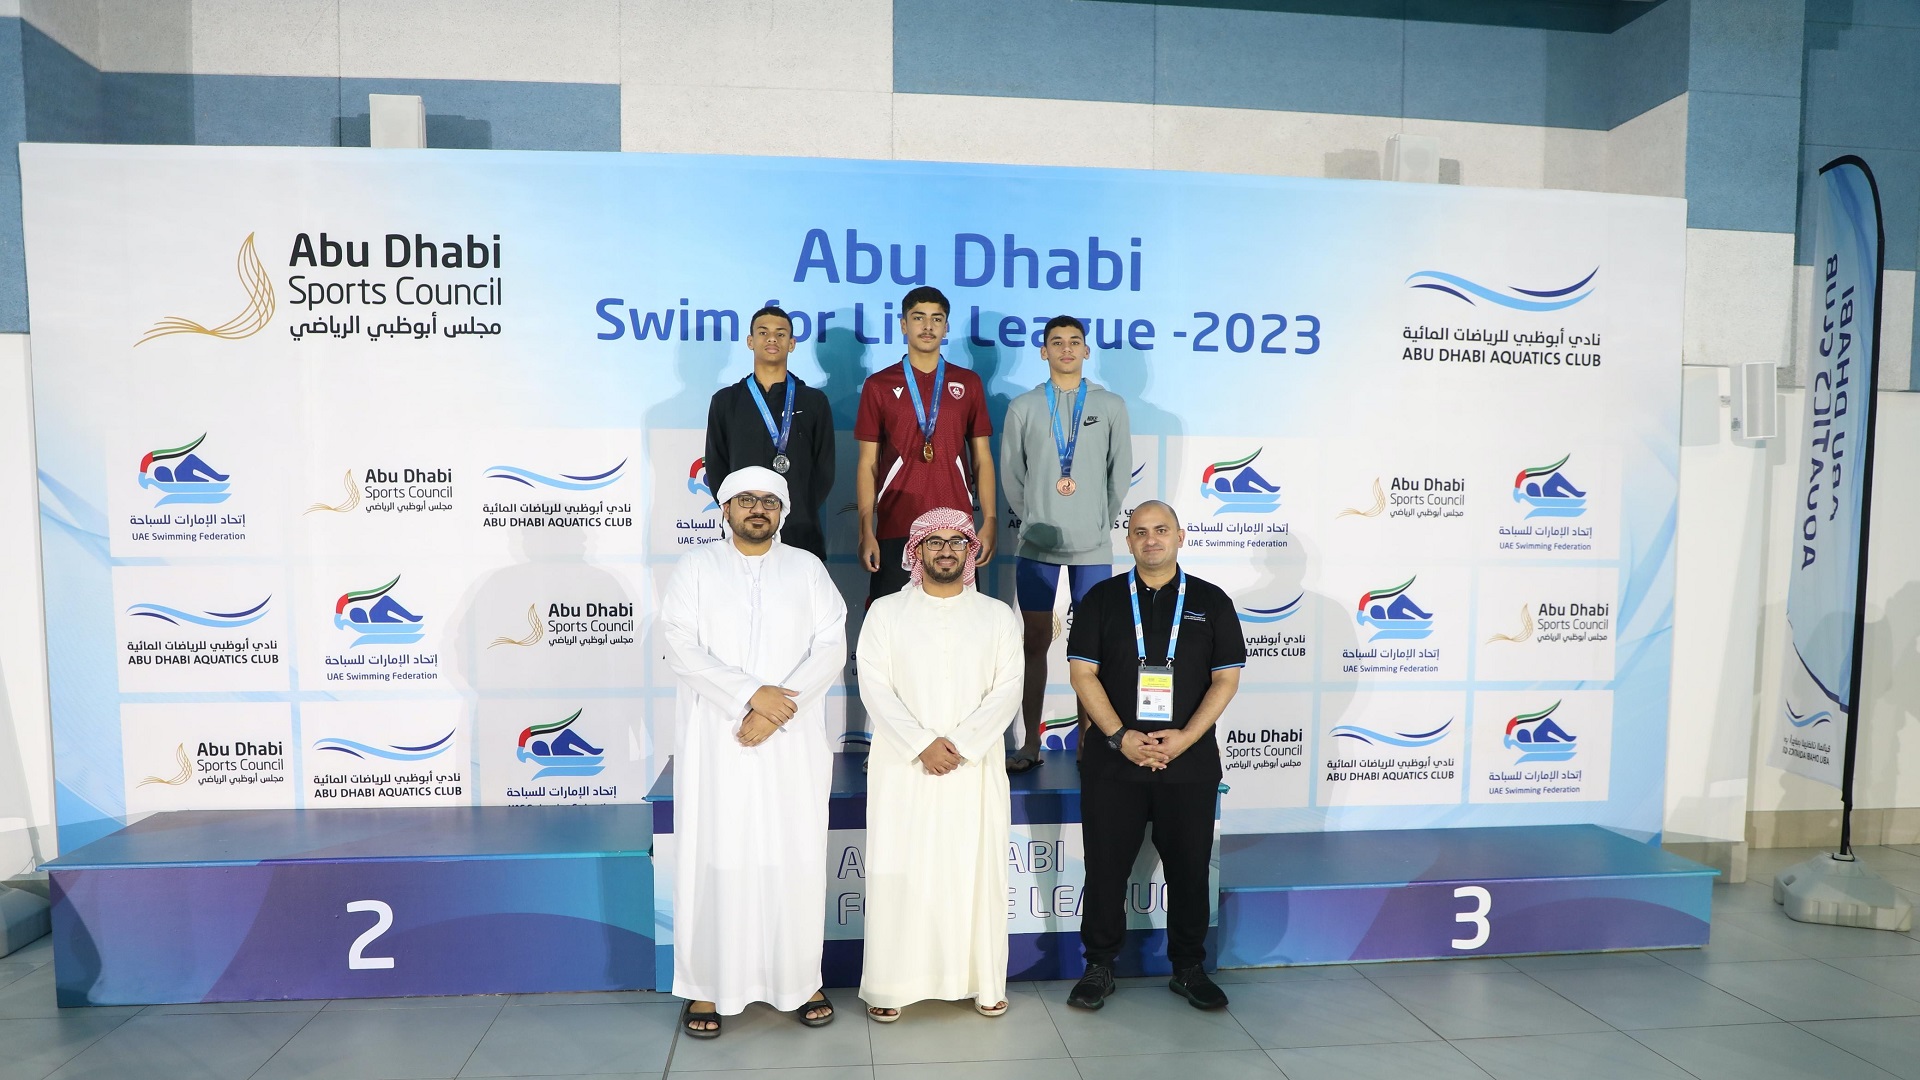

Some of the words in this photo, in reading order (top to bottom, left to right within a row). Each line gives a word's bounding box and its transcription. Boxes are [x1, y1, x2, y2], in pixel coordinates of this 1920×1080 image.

[289, 232, 369, 268] Abu
[385, 233, 501, 269] Dhabi
[794, 228, 926, 286] Abu
[955, 234, 1142, 292] Dhabi
[288, 275, 387, 311] Sports
[396, 276, 502, 306] Council
[290, 315, 360, 342] الرياضي
[367, 311, 437, 342] أبوظبي
[443, 316, 502, 339] مجلس
[596, 298, 739, 341] Swim
[764, 299, 836, 343] or
[855, 302, 949, 345] Li
[1174, 313, 1321, 356] -2023
[1403, 325, 1449, 343] المائية
[1453, 328, 1509, 346] للرياضات
[1513, 327, 1565, 348] أبوظبي
[1568, 333, 1601, 348] نادي
[1402, 347, 1434, 361] ABU
[1439, 348, 1486, 363] DHABI
[1489, 350, 1561, 366] AQUATICS
[1565, 353, 1601, 367] CLUB
[365, 468, 398, 483] Abu
[404, 468, 452, 483] Dhabi
[1390, 477, 1419, 491] Abu
[1424, 477, 1465, 492] Dhabi
[364, 486, 406, 501] Sports
[408, 485, 453, 498] Council
[396, 500, 426, 513] أبوظبي
[1390, 493, 1425, 507] Sports
[1427, 493, 1465, 506] Council
[365, 502, 395, 513] الرياضي
[428, 502, 453, 512] مجلس
[482, 502, 517, 515] المائية
[520, 503, 561, 516] للرياضات
[564, 500, 603, 516] أبوظبي
[606, 503, 631, 515] نادي
[1390, 508, 1415, 518] الرياضي
[1416, 507, 1442, 519] أبوظبي
[1443, 509, 1464, 518] مجلس
[130, 514, 171, 527] للسباحة
[174, 514, 217, 528] الإمارات
[220, 514, 246, 527] إتحاد
[483, 517, 506, 527] ABU
[510, 517, 545, 527] DHABI
[547, 517, 602, 528] AQUATICS
[604, 517, 632, 527] CLUB
[676, 518, 715, 531] للسباحة
[1008, 519, 1022, 528] AB
[1187, 522, 1223, 535] للسباحة
[1226, 522, 1264, 535] الإمارات
[1266, 523, 1289, 536] إتحاد
[1499, 526, 1532, 537] للسباحة
[1535, 526, 1569, 538] الإمارات
[1572, 527, 1592, 539] إتحاد
[132, 532, 150, 541] UAE
[152, 532, 197, 542] Swimming
[199, 532, 246, 540] Federation
[677, 536, 694, 544] UAE
[1188, 539, 1203, 547] UAE
[1205, 539, 1245, 549] Swimming
[1247, 539, 1288, 547] Federation
[1516, 542, 1552, 551] Swimming
[1554, 542, 1591, 550] Federation
[548, 603, 581, 618] Abu
[586, 602, 633, 617] Dhabi
[1538, 603, 1566, 616] Abu
[1570, 603, 1609, 617] Dhabi
[548, 620, 588, 635] Sports
[590, 619, 634, 632] Council
[1537, 618, 1570, 632] Sports
[1573, 618, 1609, 630] Council
[548, 635, 577, 647] الرياضي
[579, 633, 608, 647] أبوظبي
[609, 635, 634, 645] مجلس
[1246, 631, 1281, 646] أبوظبي
[1283, 634, 1305, 646] نادي
[1537, 633, 1561, 643] الرياضي
[1562, 631, 1587, 643] أبوظبي
[1588, 633, 1608, 642] مجلس
[127, 640, 162, 653] المائية
[165, 640, 207, 653] للرياضات
[209, 637, 249, 653] أبوظبي
[252, 640, 277, 652] نادي
[1246, 648, 1279, 657] UATICS
[1281, 647, 1306, 657] CLUB
[1342, 648, 1377, 660] للسباحة
[1380, 648, 1416, 661] الإمارات
[1418, 648, 1440, 661] إتحاد
[128, 655, 152, 665] ABU
[155, 655, 190, 665] DHABI
[193, 654, 248, 665] AQUATICS
[250, 654, 279, 664] CLUB
[325, 654, 365, 668] للسباحة
[368, 654, 410, 667] الإمارات
[413, 654, 438, 667] إتحاد
[1343, 665, 1358, 673] UAE
[1360, 665, 1398, 674] Swimming
[327, 672, 344, 681] UAE
[346, 672, 390, 682] Swimming
[392, 671, 438, 680] Federation
[1226, 729, 1256, 744] Abu
[1260, 728, 1303, 743] Dhabi
[197, 742, 230, 757] Abu
[235, 741, 283, 756] Dhabi
[1226, 745, 1261, 760] Sports
[1264, 744, 1303, 757] Council
[196, 759, 237, 774] Sports
[240, 758, 284, 771] Council
[1225, 760, 1251, 771] الرياضي
[1252, 757, 1279, 770] أبوظبي
[1280, 759, 1302, 769] مجلس
[1326, 759, 1357, 771] المائية
[1359, 759, 1395, 770] للرياضات
[1397, 756, 1431, 770] أبوظبي
[1433, 758, 1454, 769] نادي
[198, 774, 227, 786] الرياضي
[229, 772, 258, 786] أبوظبي
[260, 774, 284, 784] مجلس
[313, 774, 347, 786] المائية
[350, 773, 391, 786] للرياضات
[394, 770, 433, 785] أبوظبي
[435, 772, 461, 784] نادي
[1326, 772, 1347, 781] ABU
[1349, 772, 1380, 781] DHABI
[1382, 771, 1428, 781] AQUATICS
[1430, 770, 1454, 780] CLUB
[1489, 771, 1522, 783] للسباحة
[1524, 770, 1559, 782] الإمارات
[1561, 770, 1582, 782] إتحاد
[314, 788, 337, 798] ABU
[340, 788, 375, 798] DHABI
[378, 786, 432, 798] AQUATICS
[434, 786, 462, 796] CLUB
[506, 786, 546, 799] للسباحة
[549, 786, 589, 799] الإمارات
[593, 785, 617, 799] إتحاد
[1489, 787, 1503, 795] UAE
[1505, 787, 1541, 795] Swimming
[1008, 840, 1065, 873] ABI
[1451, 886, 1492, 950] 3
[346, 900, 395, 970] 2
